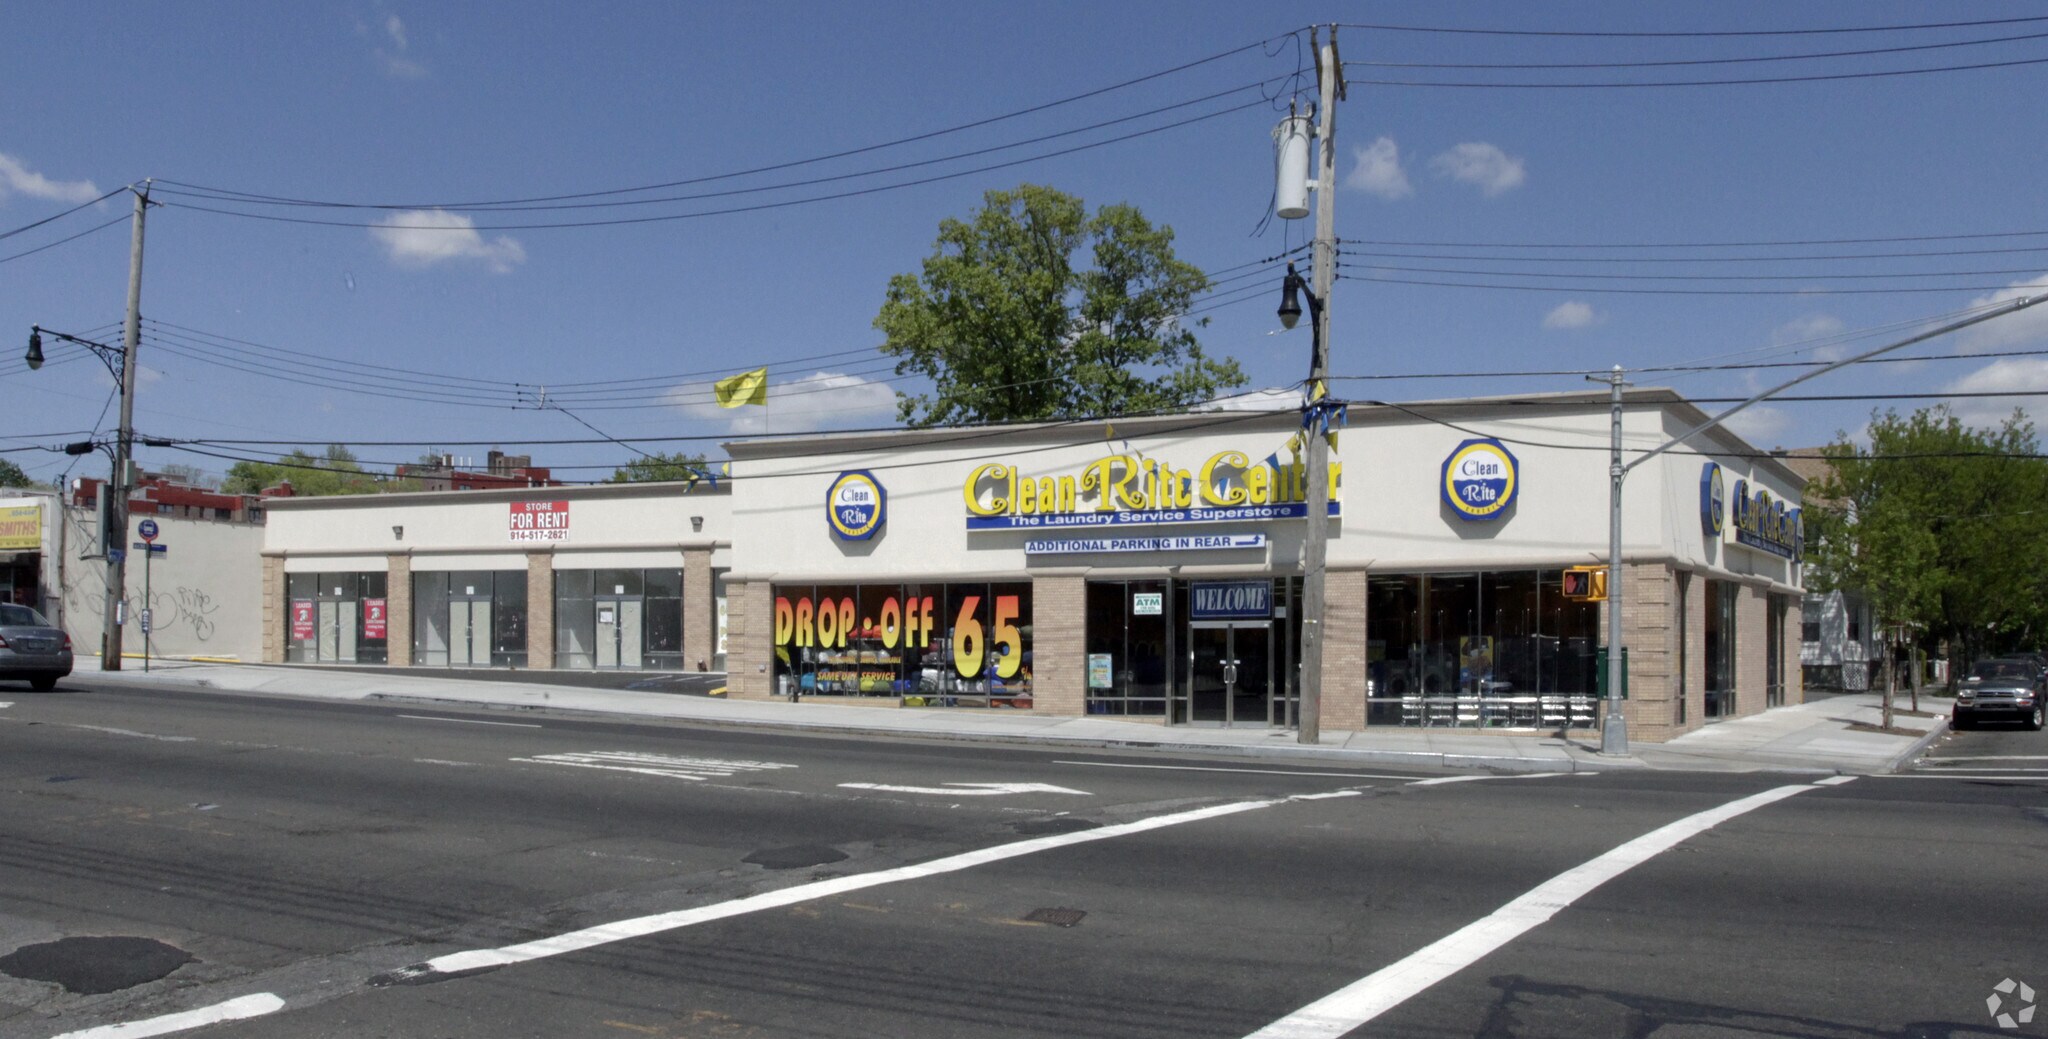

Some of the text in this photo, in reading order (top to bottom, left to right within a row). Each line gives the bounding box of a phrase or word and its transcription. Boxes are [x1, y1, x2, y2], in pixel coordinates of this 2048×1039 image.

[1462, 460, 1498, 476] Clean
[963, 450, 1342, 515] Clean Rite Centr
[841, 489, 869, 502] Clean
[1462, 482, 1496, 502] Rite
[525, 502, 553, 511] STORE
[510, 512, 568, 529] FOR RENT
[841, 507, 867, 524] Rite
[1009, 506, 1292, 526] The Laundry Service Superstore
[510, 530, 568, 540] 914-517-2621
[1028, 536, 1231, 551] ADDITIONAL PARKING IN REAR
[1136, 598, 1160, 606] ATM
[1196, 587, 1266, 611] WELCOME
[953, 595, 1022, 679] 65
[817, 671, 840, 681] SAME
[861, 671, 896, 681] SERVICE
